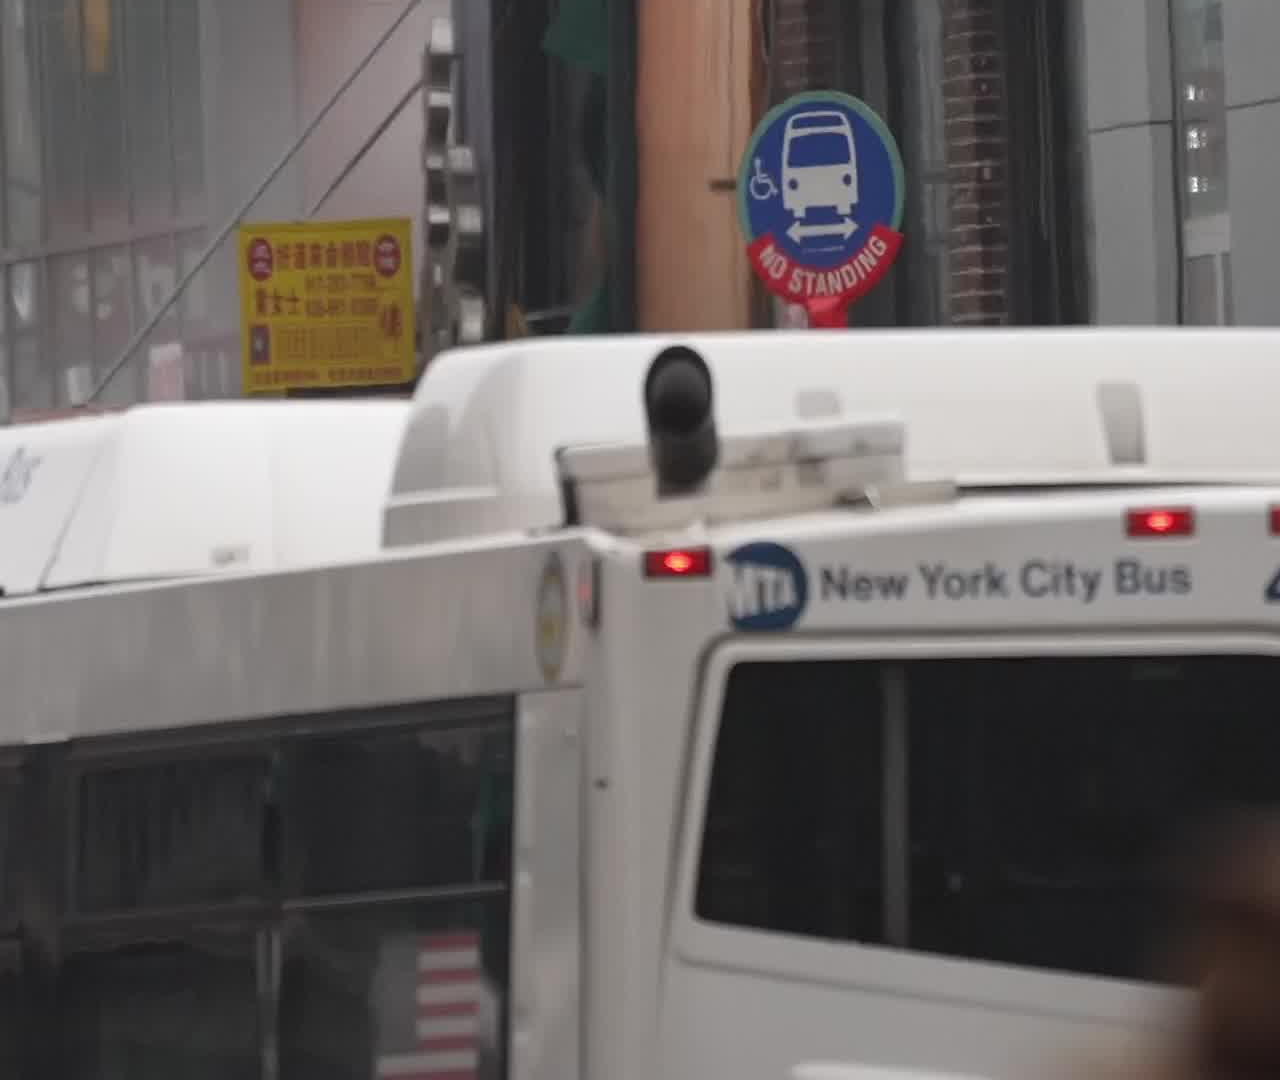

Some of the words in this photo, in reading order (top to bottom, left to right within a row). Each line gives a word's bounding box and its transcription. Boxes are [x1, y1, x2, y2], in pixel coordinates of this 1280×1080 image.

[759, 244, 788, 280] NO
[788, 234, 888, 297] STANDING
[821, 567, 910, 602] New
[918, 564, 1010, 599] York
[1020, 559, 1103, 604] City
[1114, 560, 1194, 596] Bus
